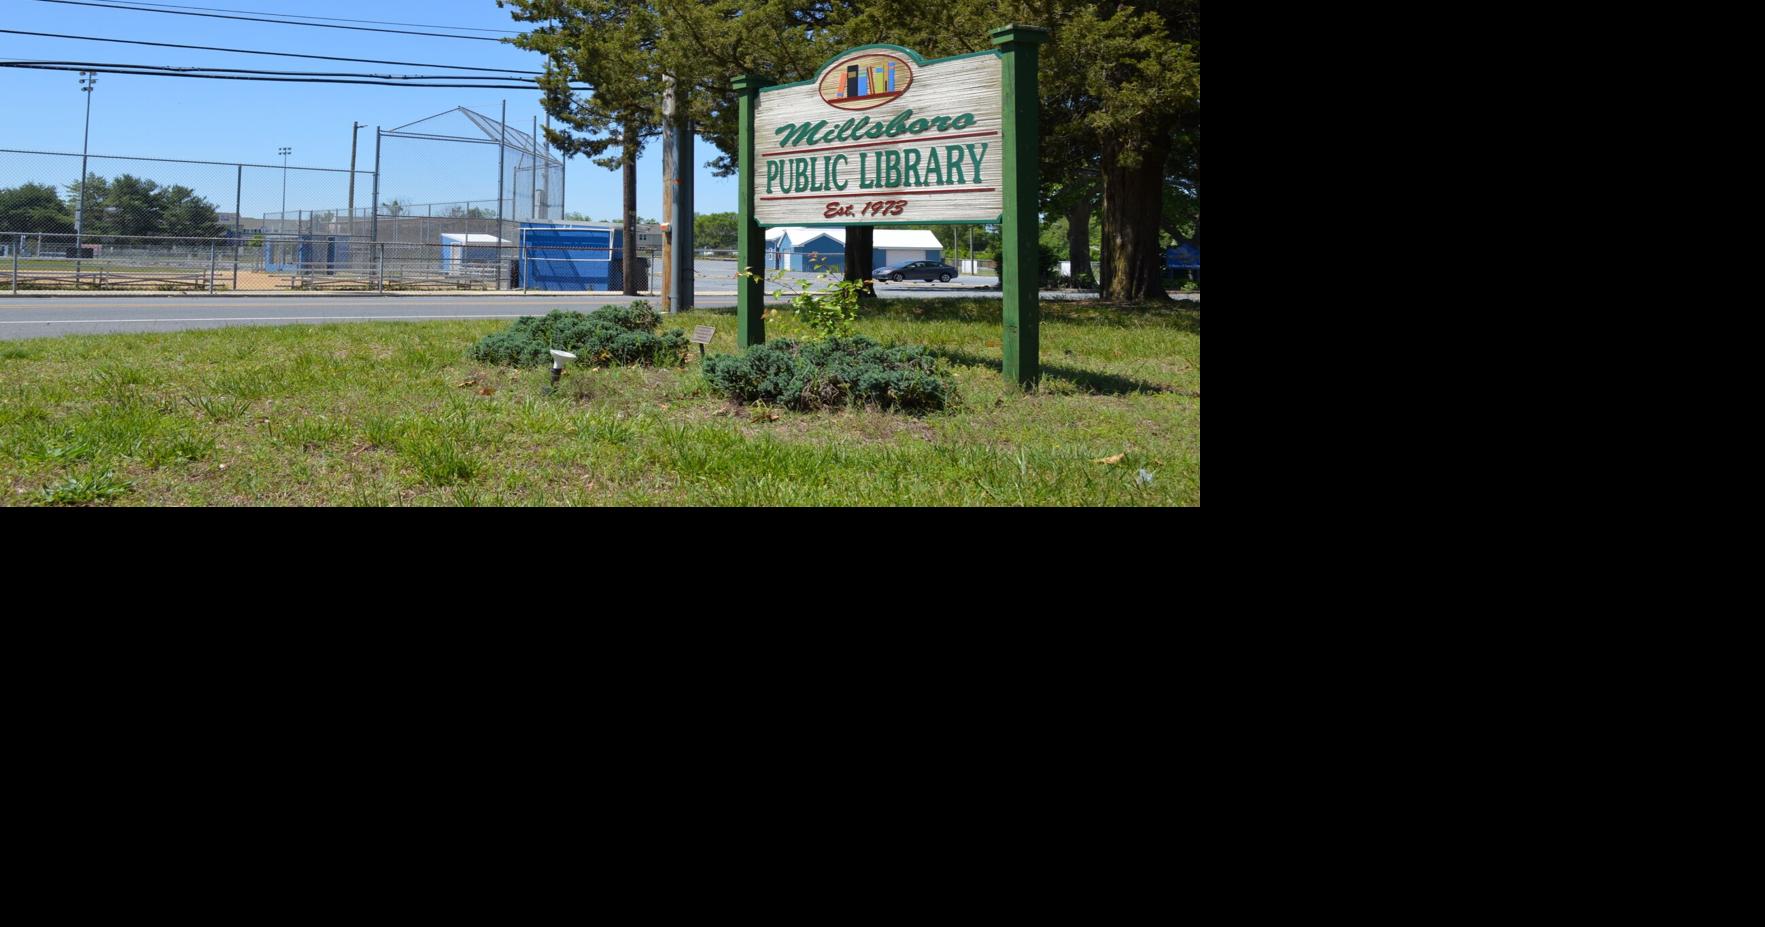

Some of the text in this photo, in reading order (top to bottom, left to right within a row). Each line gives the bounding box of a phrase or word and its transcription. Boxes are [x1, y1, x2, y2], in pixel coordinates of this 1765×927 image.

[775, 109, 977, 148] Millsboro
[765, 142, 989, 194] PUBLIC LIBRARY
[861, 199, 908, 216] 1973
